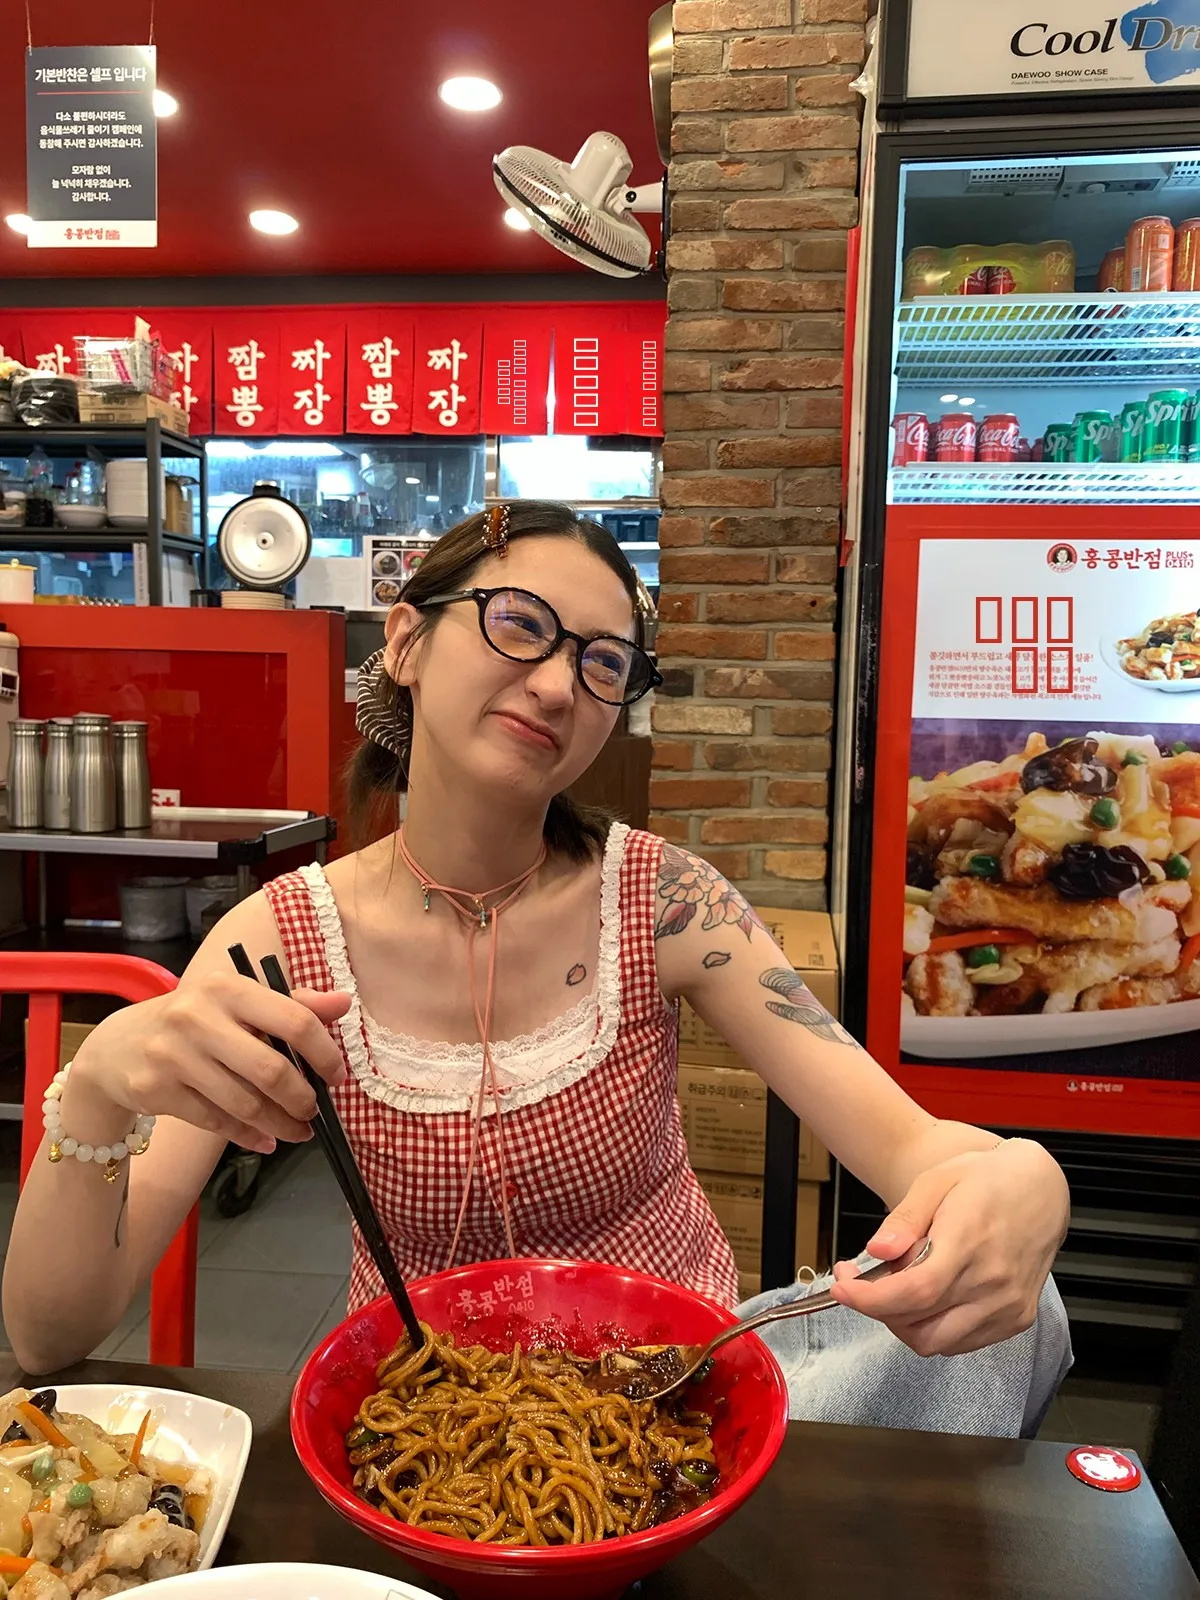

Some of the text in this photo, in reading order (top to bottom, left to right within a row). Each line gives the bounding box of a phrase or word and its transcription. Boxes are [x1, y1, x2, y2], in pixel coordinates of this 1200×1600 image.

[1010, 18, 1118, 57] Cool
[35, 67, 147, 83] 기본반찬은 셀프 입니다
[1011, 68, 1108, 79] DAEWOO SHOW CASE
[55, 111, 127, 121] 다소 불편하시더라도
[40, 125, 86, 135] 음식물쓰레기
[111, 124, 143, 134] 캠페인에
[63, 139, 86, 148] 주시면
[88, 138, 144, 148] 감사하겠습니다.
[71, 165, 111, 175] 모자람 없이
[61, 179, 83, 188] 넉넉히
[84, 178, 132, 188] 채우겠습니다.
[71, 192, 111, 202] 감사합니다.
[225, 339, 266, 427] 짬뽕
[291, 339, 332, 426] 짜장
[360, 336, 400, 426] 짬뽕
[427, 338, 468, 427] 짜장
[1081, 548, 1161, 569] 홍콩반점
[455, 1271, 534, 1315] 홍콩반점
[508, 1300, 535, 1313] 0410
